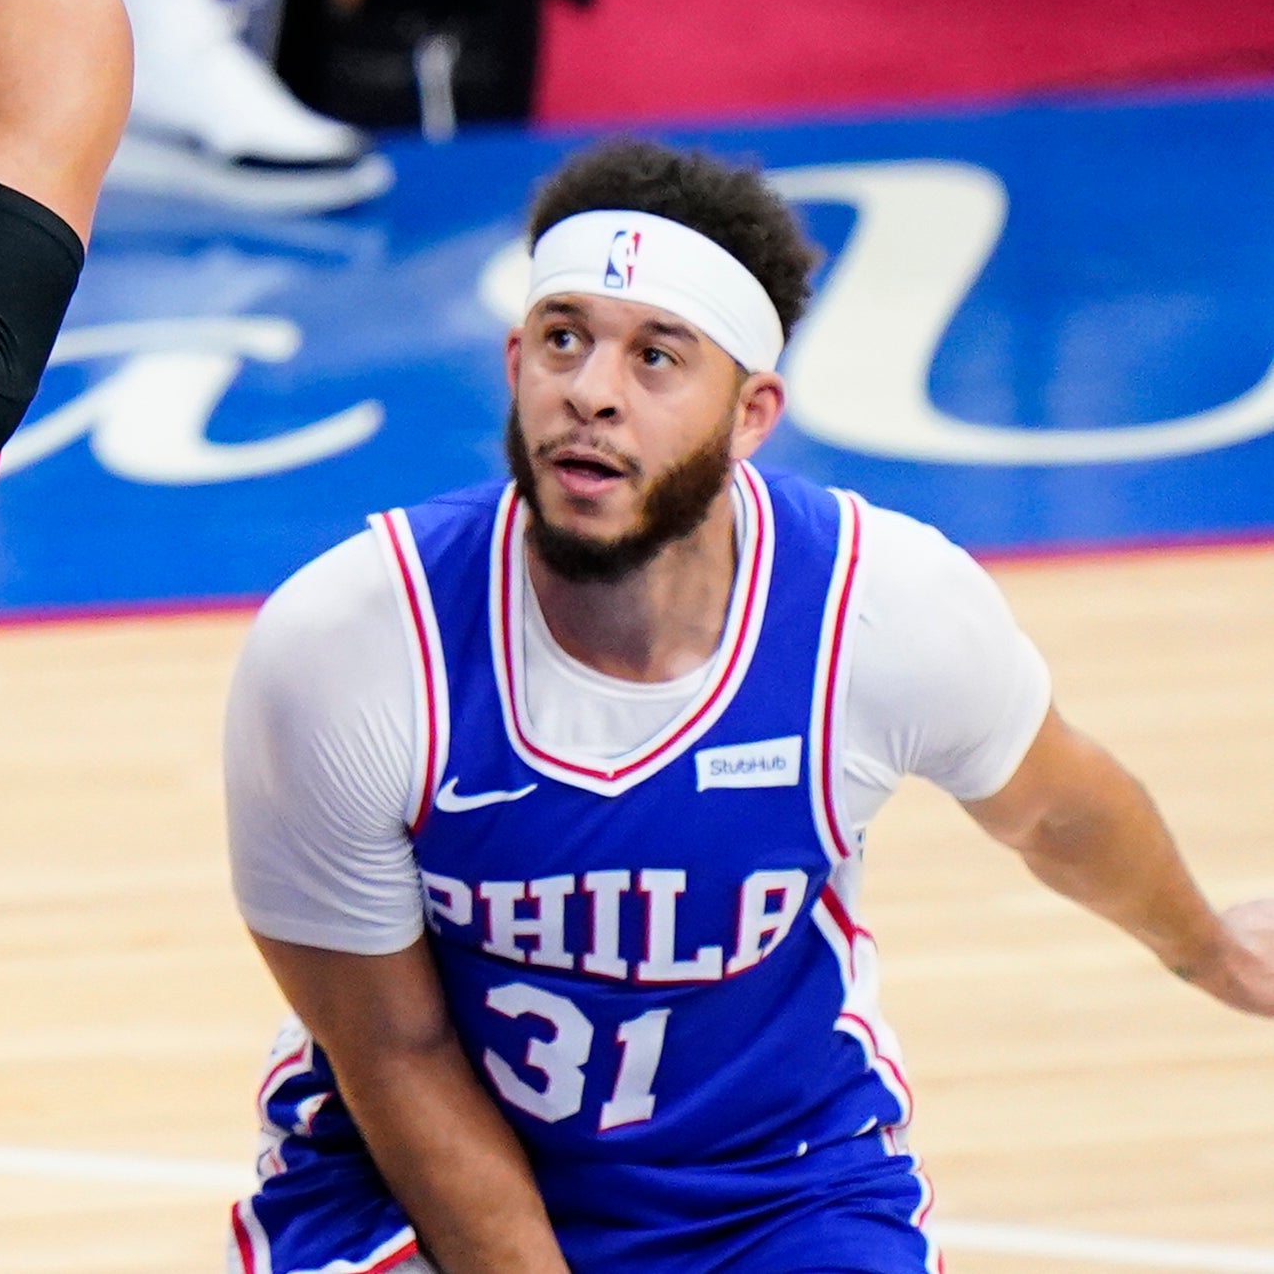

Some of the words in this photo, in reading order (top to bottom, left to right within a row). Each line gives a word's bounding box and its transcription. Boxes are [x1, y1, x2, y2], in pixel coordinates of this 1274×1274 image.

[709, 755, 787, 777] StubHub
[420, 869, 810, 987] PHILA
[483, 982, 673, 1134] 31
